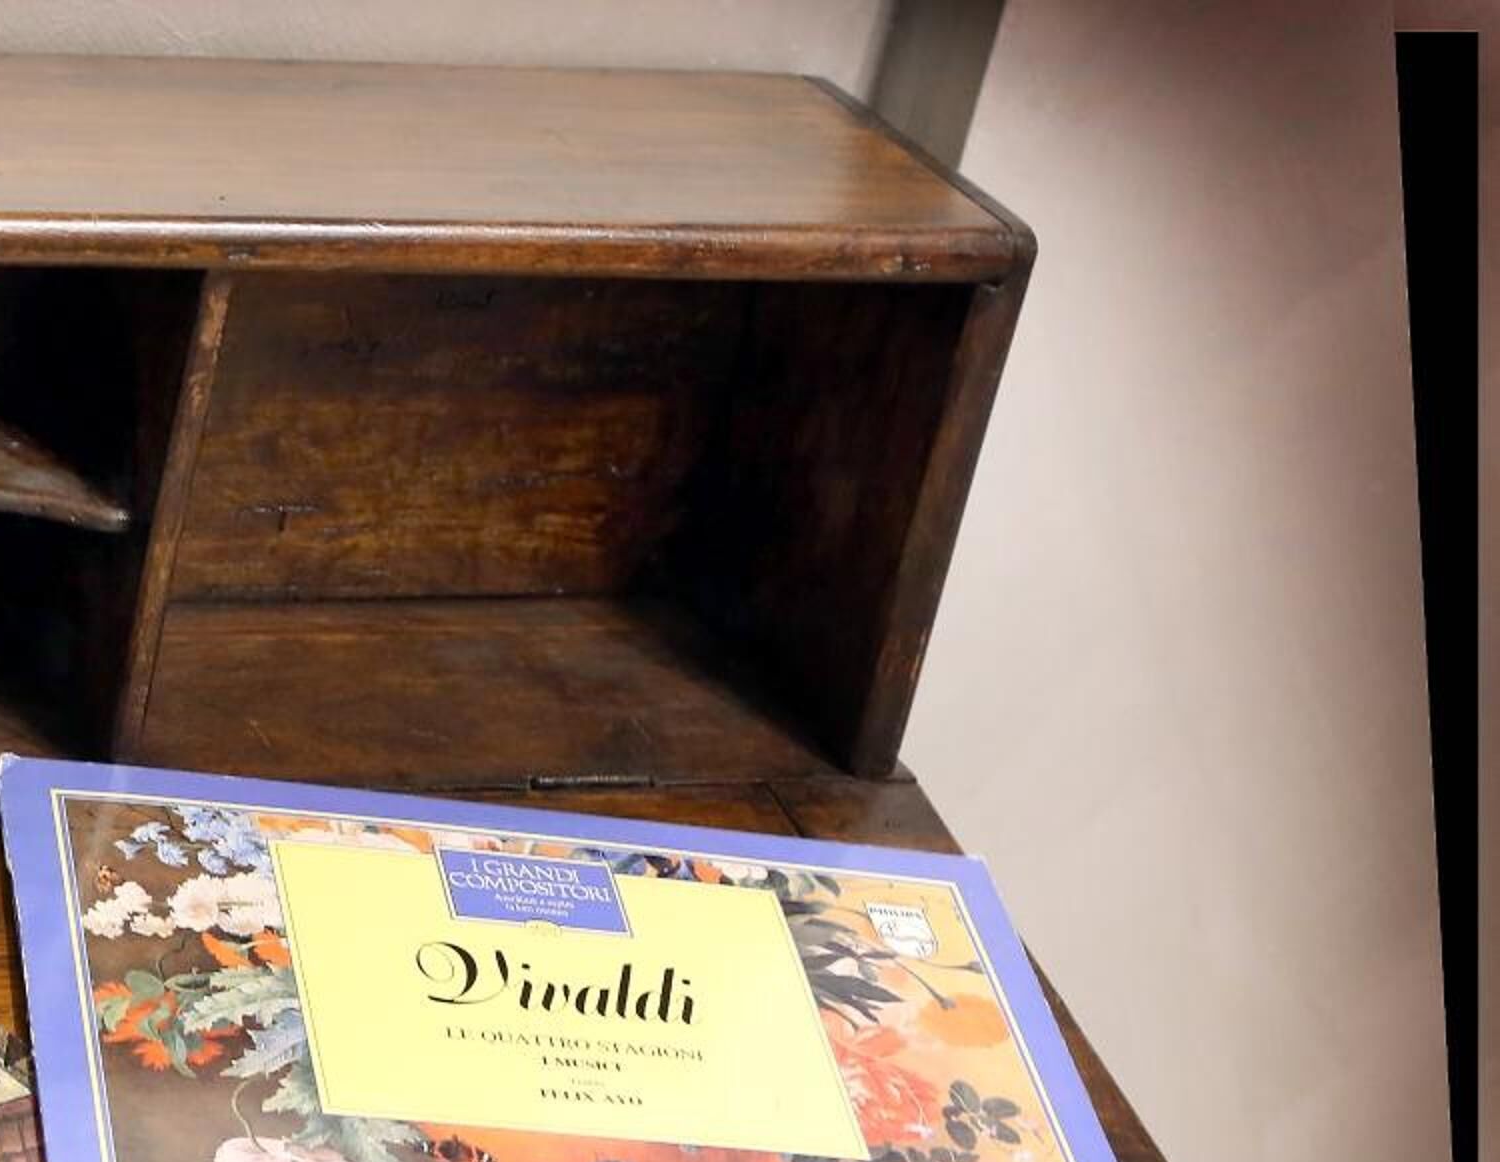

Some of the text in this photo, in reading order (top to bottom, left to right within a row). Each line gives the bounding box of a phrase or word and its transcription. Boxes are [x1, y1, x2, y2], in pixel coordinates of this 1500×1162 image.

[449, 871, 612, 903] COMPOSITORI
[483, 861, 580, 884] GRANDI
[416, 941, 696, 1024] Vivaldi
[480, 1030, 592, 1051] QUATTRO
[596, 1039, 705, 1062] STAGIONI
